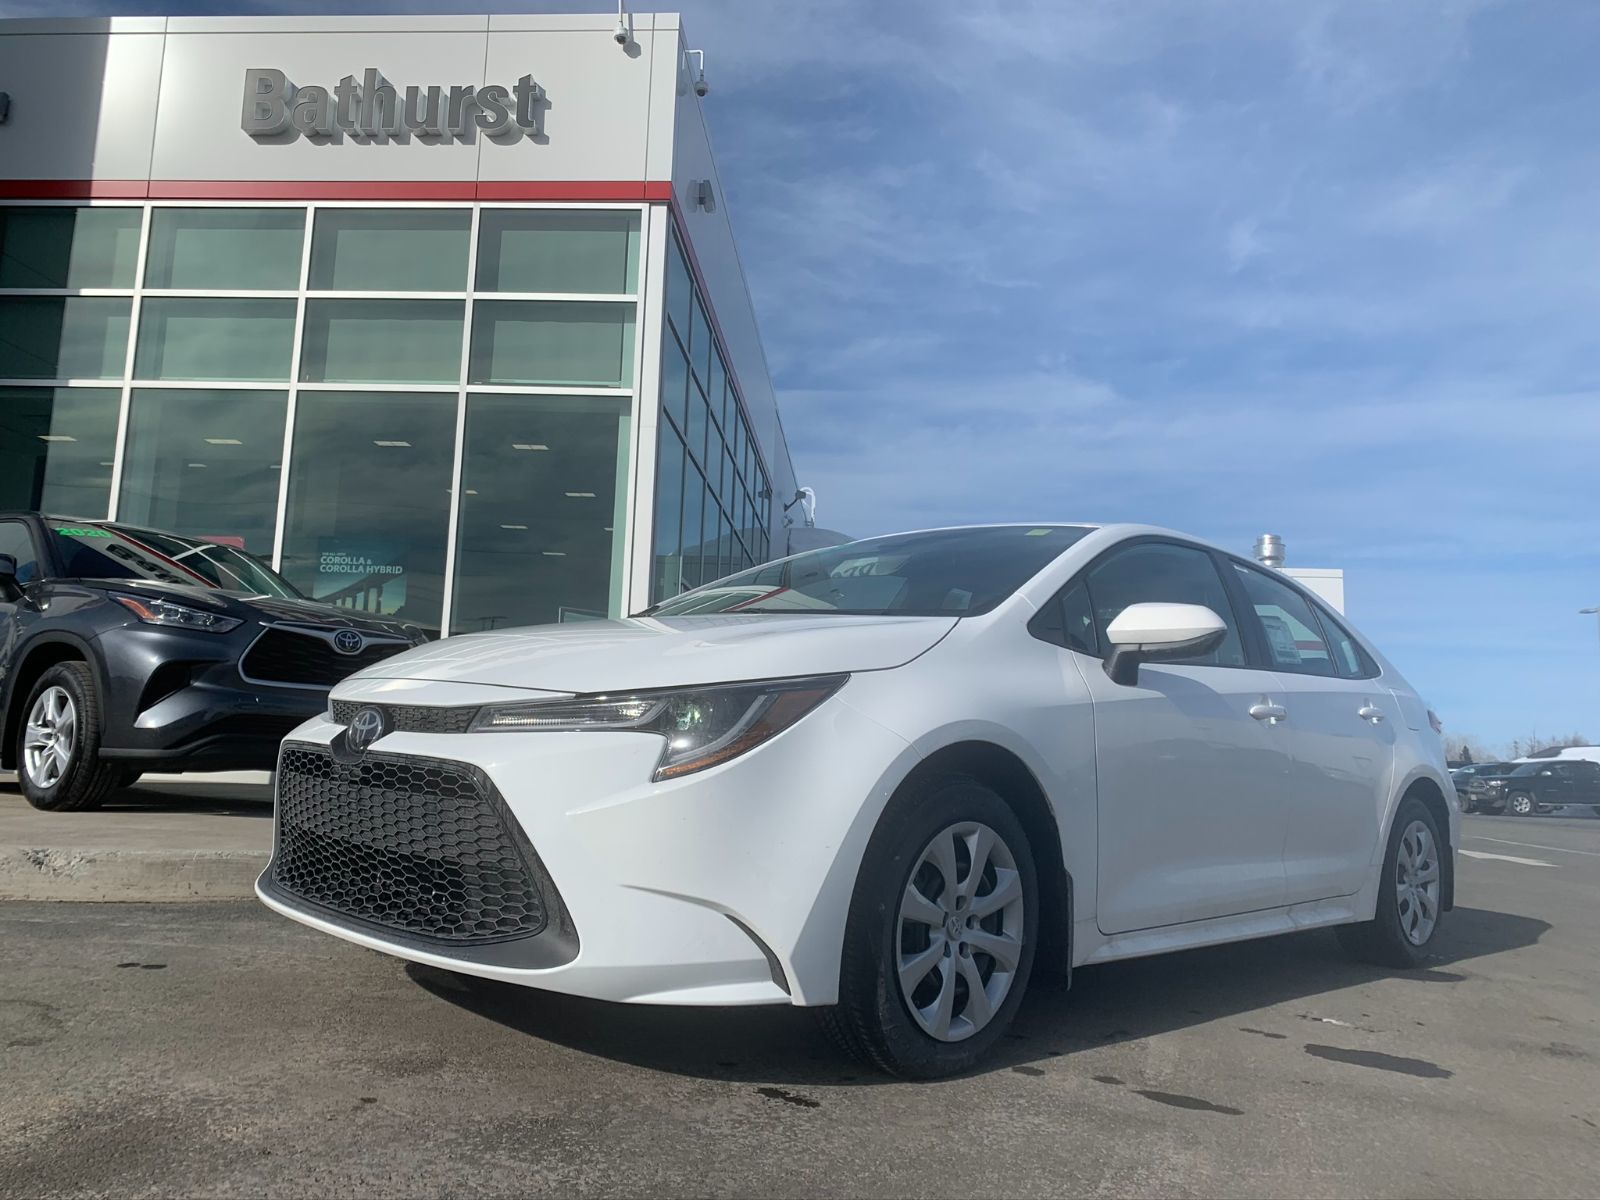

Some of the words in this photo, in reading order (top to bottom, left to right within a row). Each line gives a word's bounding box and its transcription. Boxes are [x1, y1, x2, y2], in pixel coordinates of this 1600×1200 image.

[241, 68, 545, 138] Bathurst
[56, 526, 112, 538] 2020
[320, 556, 365, 564] COROLLA
[320, 564, 364, 573] COROLLA
[366, 565, 403, 574] HYBRID
